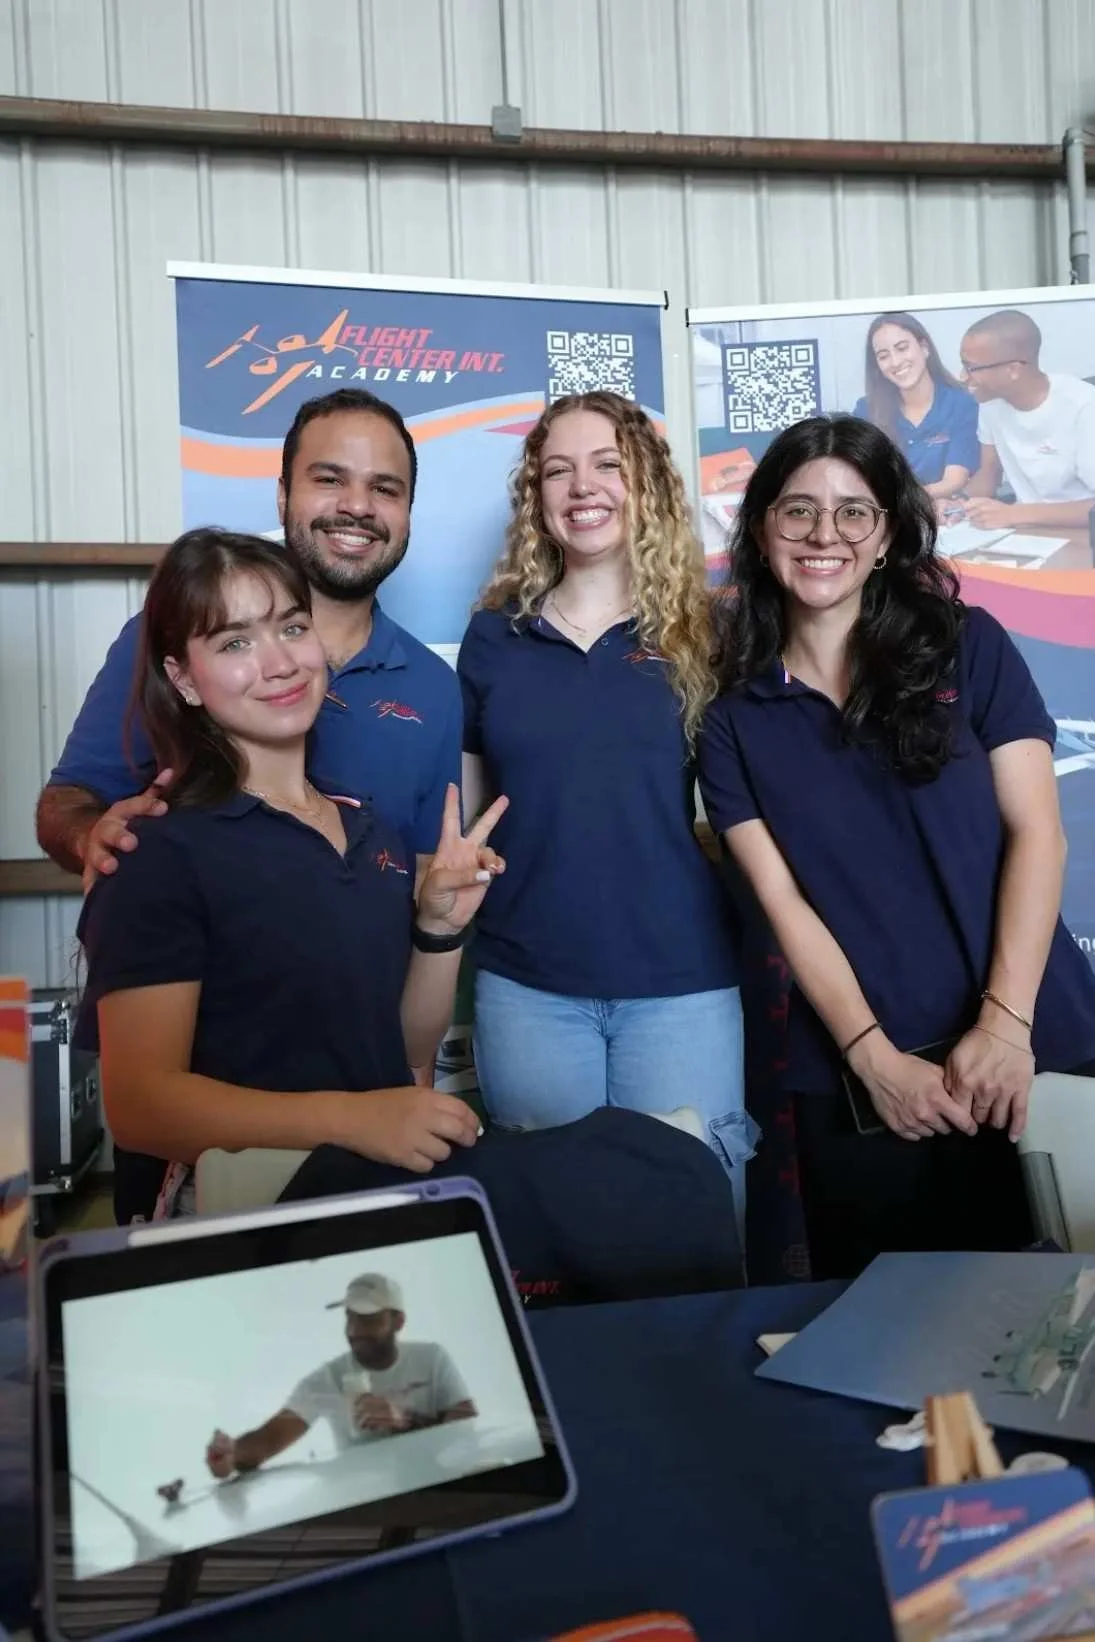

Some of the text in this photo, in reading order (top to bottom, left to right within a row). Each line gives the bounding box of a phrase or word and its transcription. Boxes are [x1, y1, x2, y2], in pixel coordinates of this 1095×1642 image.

[340, 325, 432, 348] FLIGHT
[357, 346, 505, 373] CENTER INT.
[306, 365, 458, 383] ACADEMY
